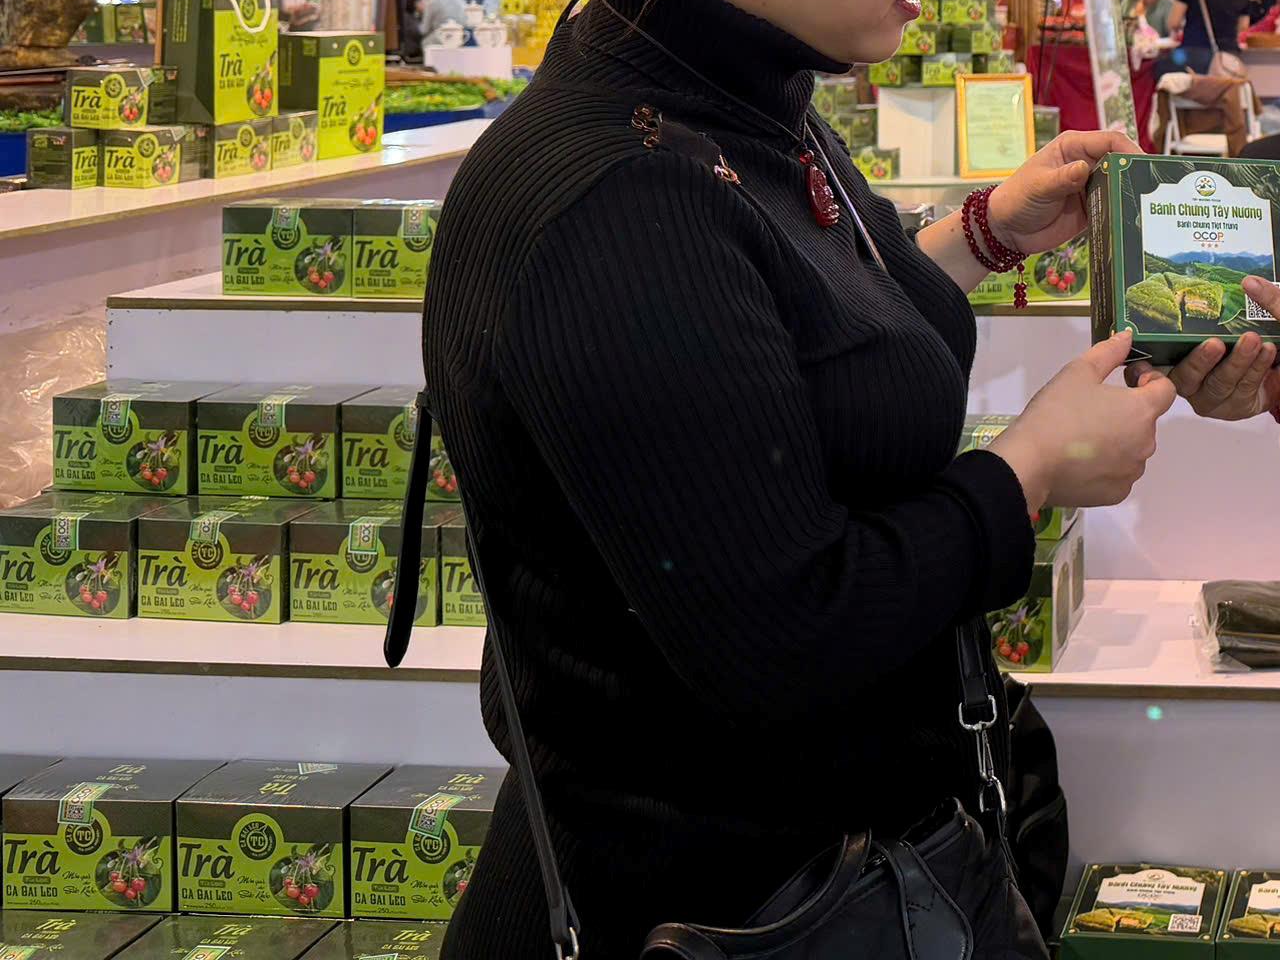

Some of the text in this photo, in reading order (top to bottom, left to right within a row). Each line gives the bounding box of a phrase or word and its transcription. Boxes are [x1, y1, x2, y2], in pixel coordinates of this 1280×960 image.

[219, 53, 243, 77] Trà
[74, 89, 102, 108] Trà
[322, 95, 347, 117] Trà
[106, 149, 136, 168] Trà
[1193, 231, 1224, 240] OCOP
[224, 238, 267, 267] Trà
[355, 240, 399, 269] Trà
[55, 430, 98, 460] Trà
[200, 435, 245, 465] Trà
[344, 438, 390, 469] Trà
[141, 554, 189, 588] Trà
[292, 557, 341, 591] Trà
[77, 830, 91, 840] TC
[250, 835, 264, 846] TC
[4, 839, 61, 875] Trà
[179, 842, 236, 880] Trà
[353, 846, 409, 884] Trà
[21, 885, 37, 897] GAI
[40, 886, 58, 897] LEO
[197, 889, 213, 900] GAI
[216, 889, 233, 901] LEO
[370, 893, 386, 905] GAI
[389, 894, 406, 906] LEO
[393, 929, 433, 941] Trà
